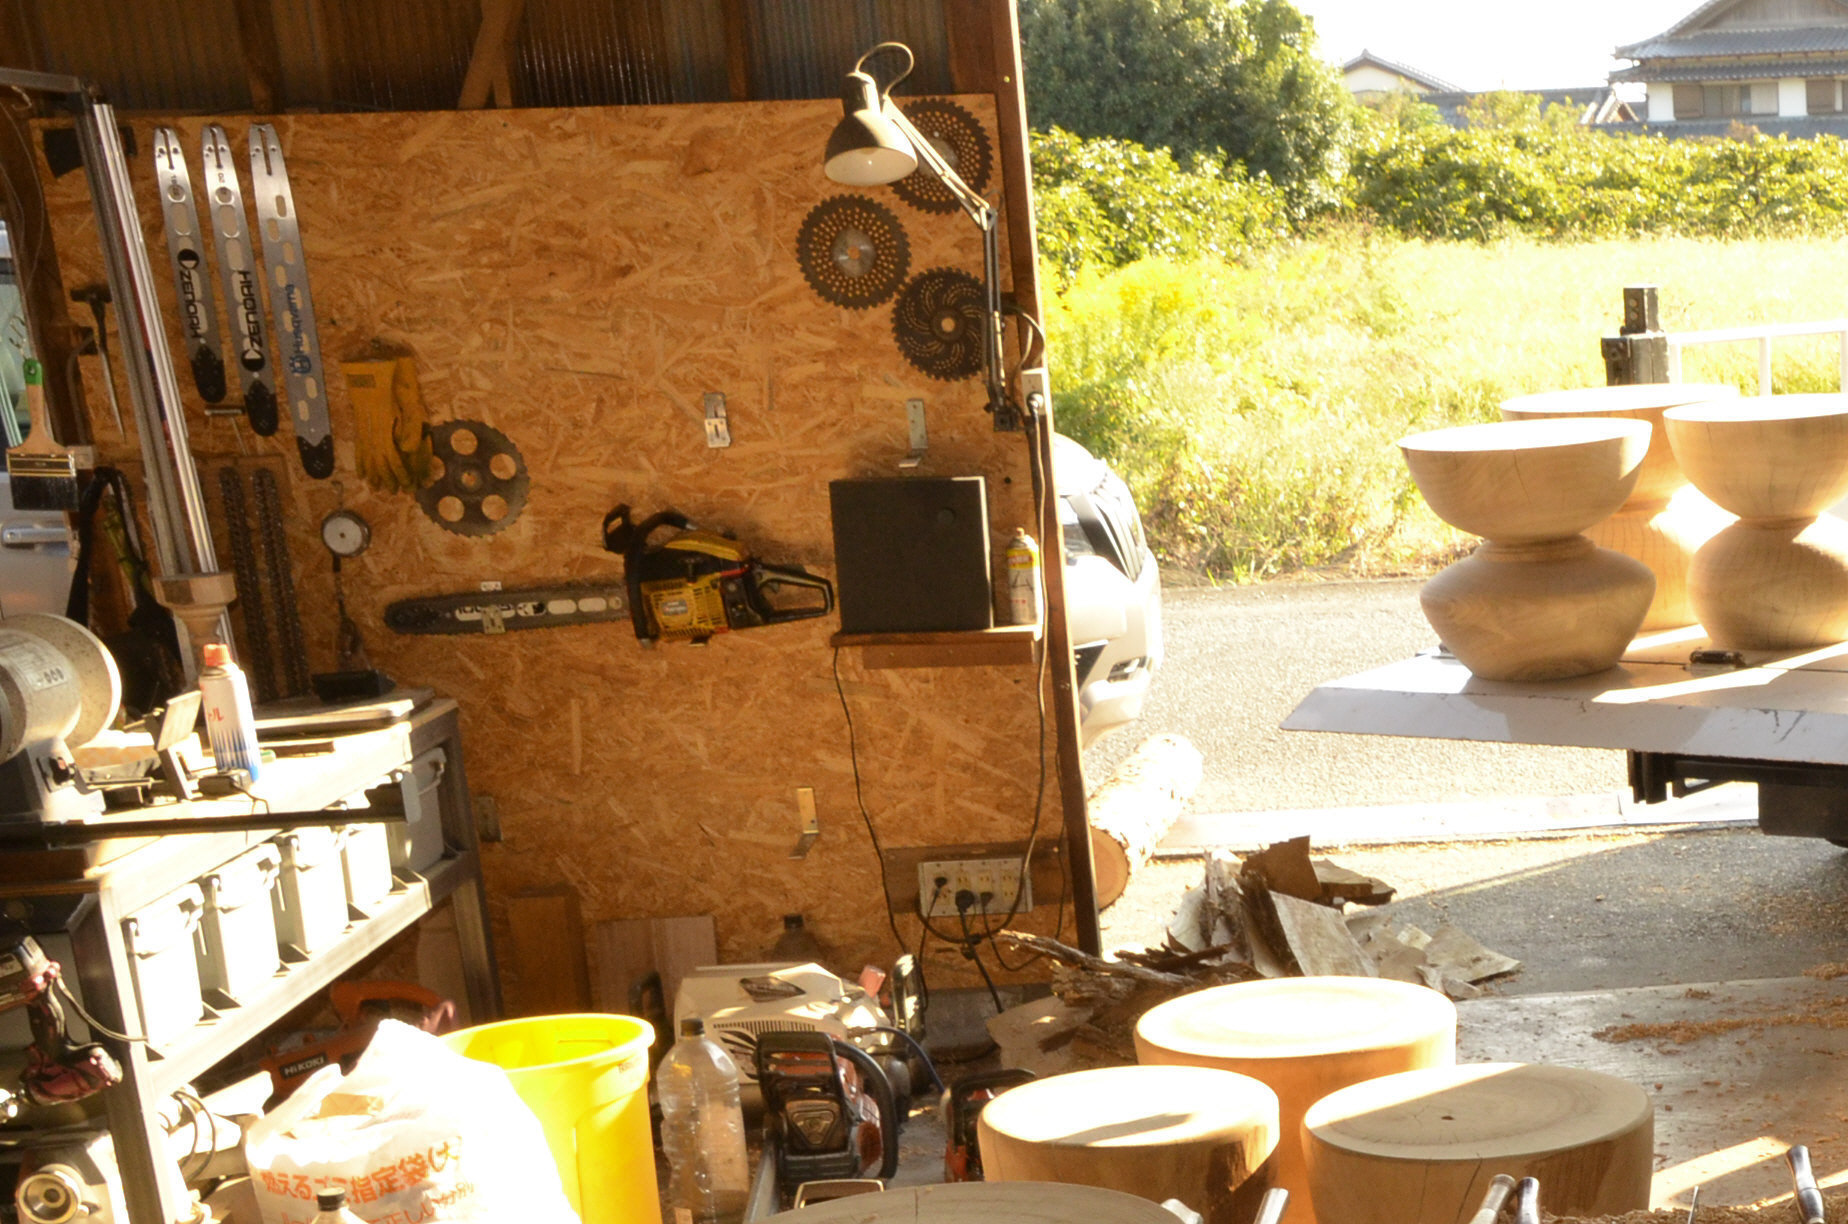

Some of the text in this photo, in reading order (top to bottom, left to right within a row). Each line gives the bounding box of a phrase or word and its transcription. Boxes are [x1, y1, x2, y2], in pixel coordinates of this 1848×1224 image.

[179, 270, 201, 339] ZENOAH
[237, 270, 262, 349] ZENOAH
[284, 284, 304, 354] Husqvarna
[284, 1056, 325, 1076] HiKOKI
